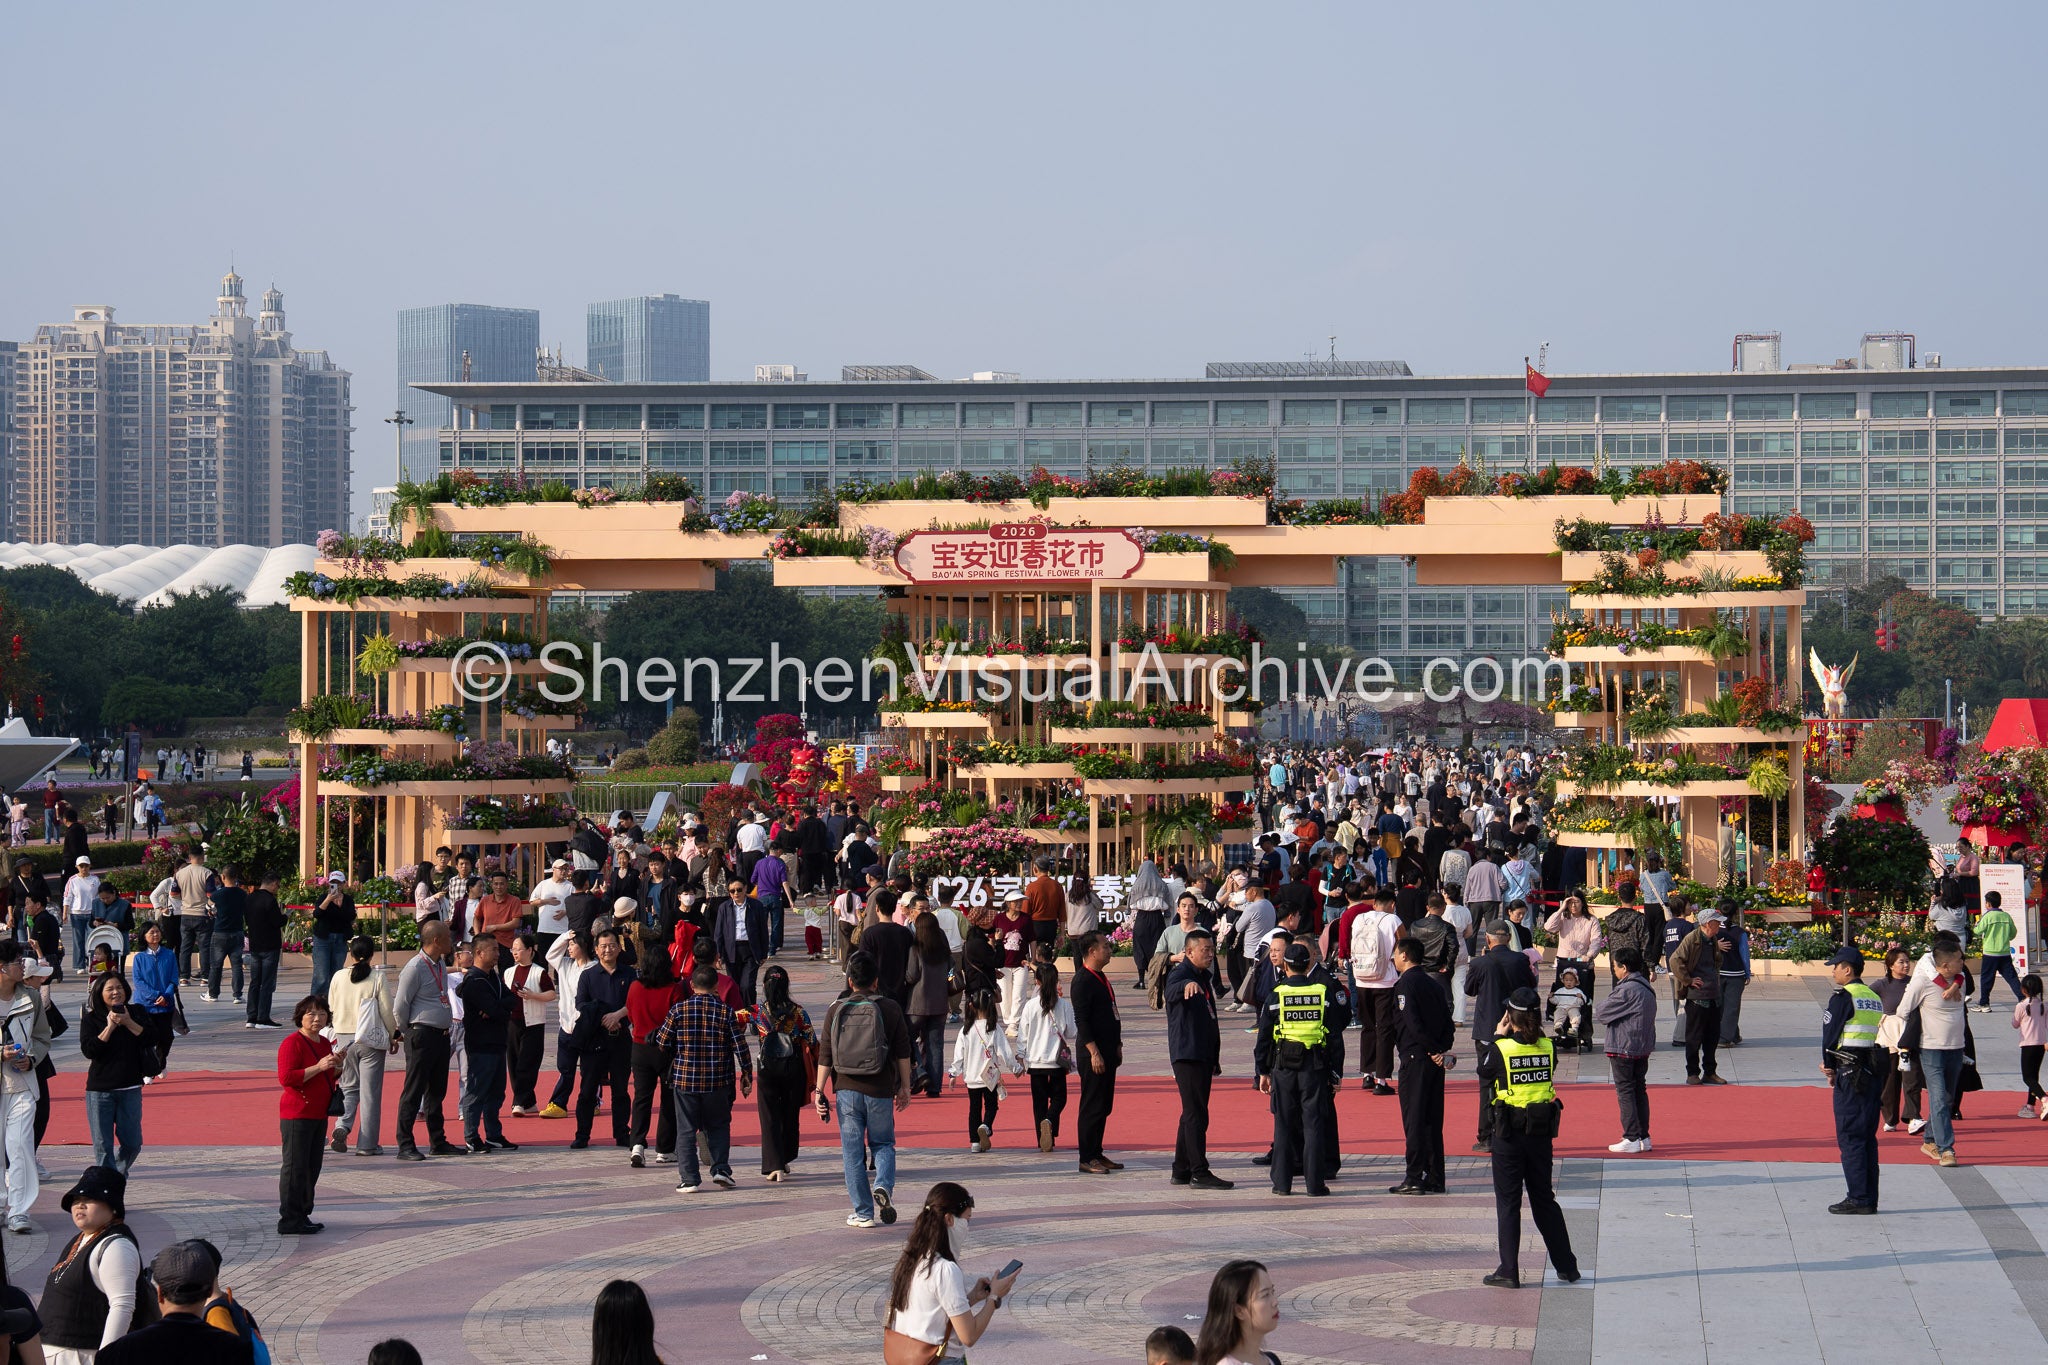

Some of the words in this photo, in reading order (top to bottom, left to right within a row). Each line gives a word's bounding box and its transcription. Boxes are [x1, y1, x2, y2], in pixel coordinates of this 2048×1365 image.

[1001, 527, 1036, 537] 2026
[931, 539, 1105, 570] 宝安迎春花市
[931, 571, 964, 579] BAO'AN
[1005, 570, 1043, 578] FESTIVAL
[1084, 569, 1104, 577] FAIR
[1285, 996, 1320, 1005] 深圳警察
[1286, 1011, 1319, 1020] POLICE
[1511, 1056, 1550, 1068] 深圳警察
[1513, 1070, 1549, 1083] POLICE
